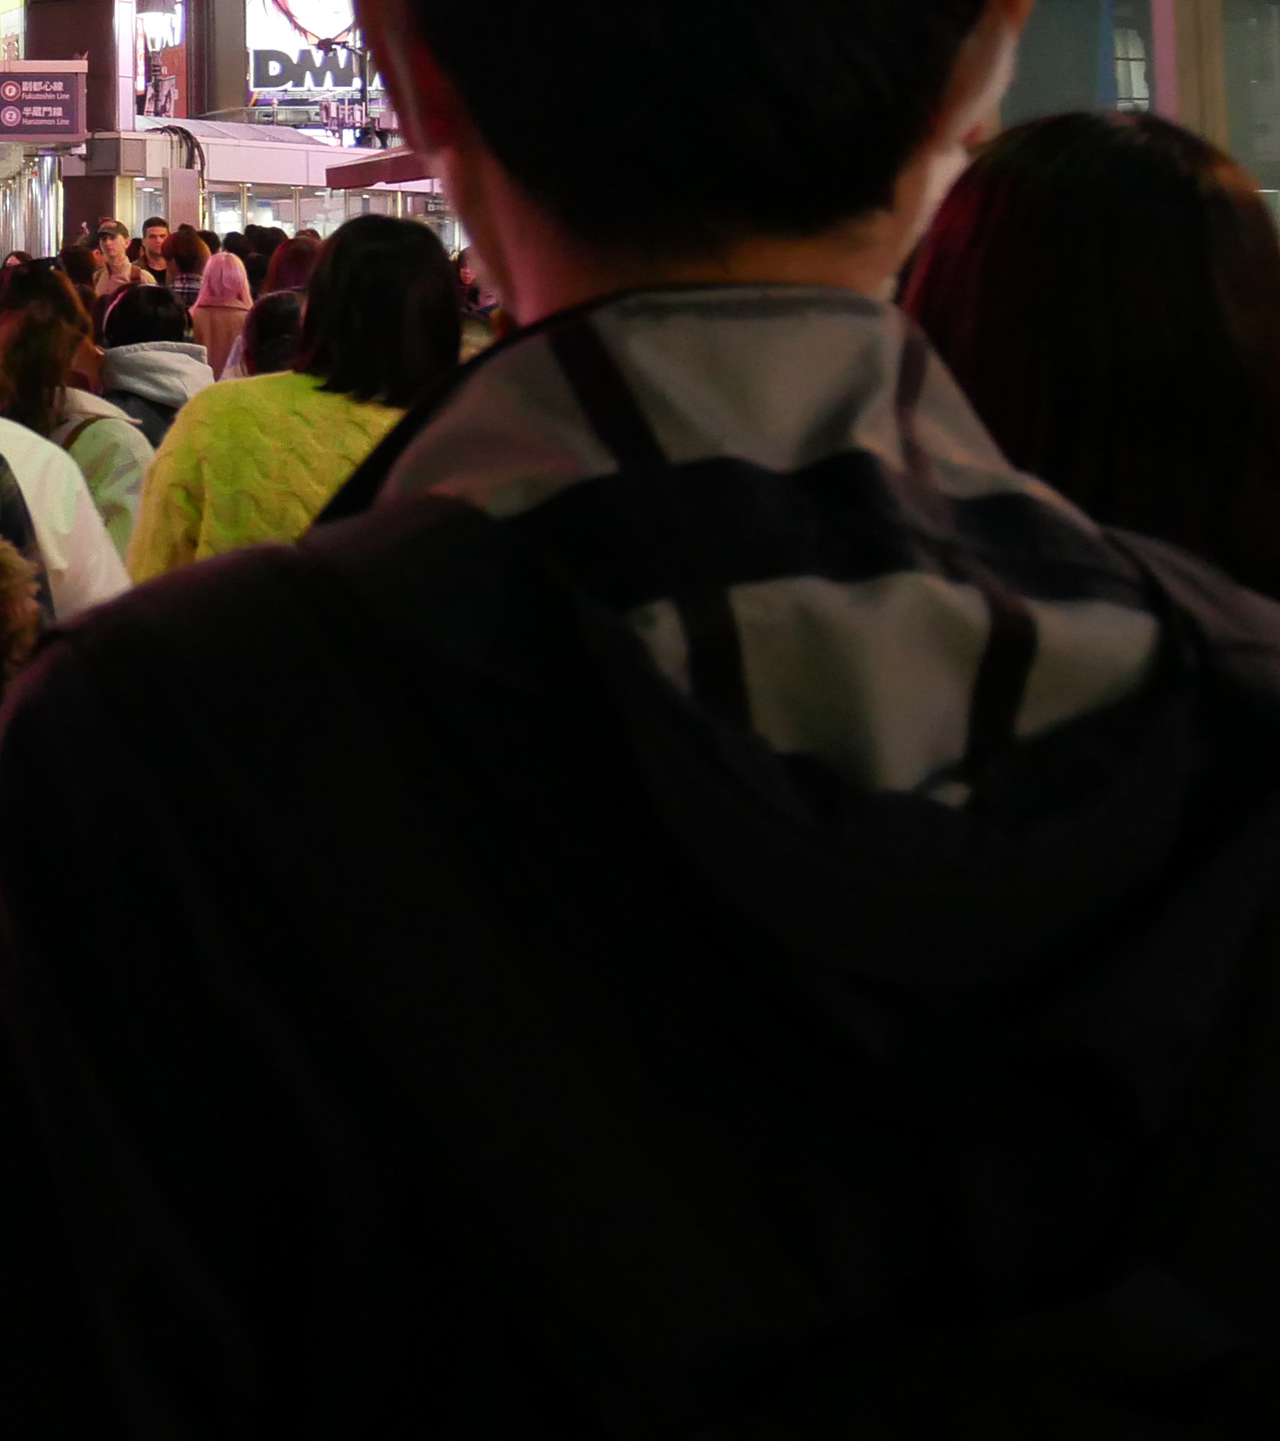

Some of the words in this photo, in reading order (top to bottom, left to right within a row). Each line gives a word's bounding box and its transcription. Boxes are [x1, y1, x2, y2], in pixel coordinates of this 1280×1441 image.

[21, 81, 64, 92] 副都心線
[56, 92, 70, 100] Line
[21, 106, 64, 117] 半蔵門線
[56, 118, 70, 126] Line
